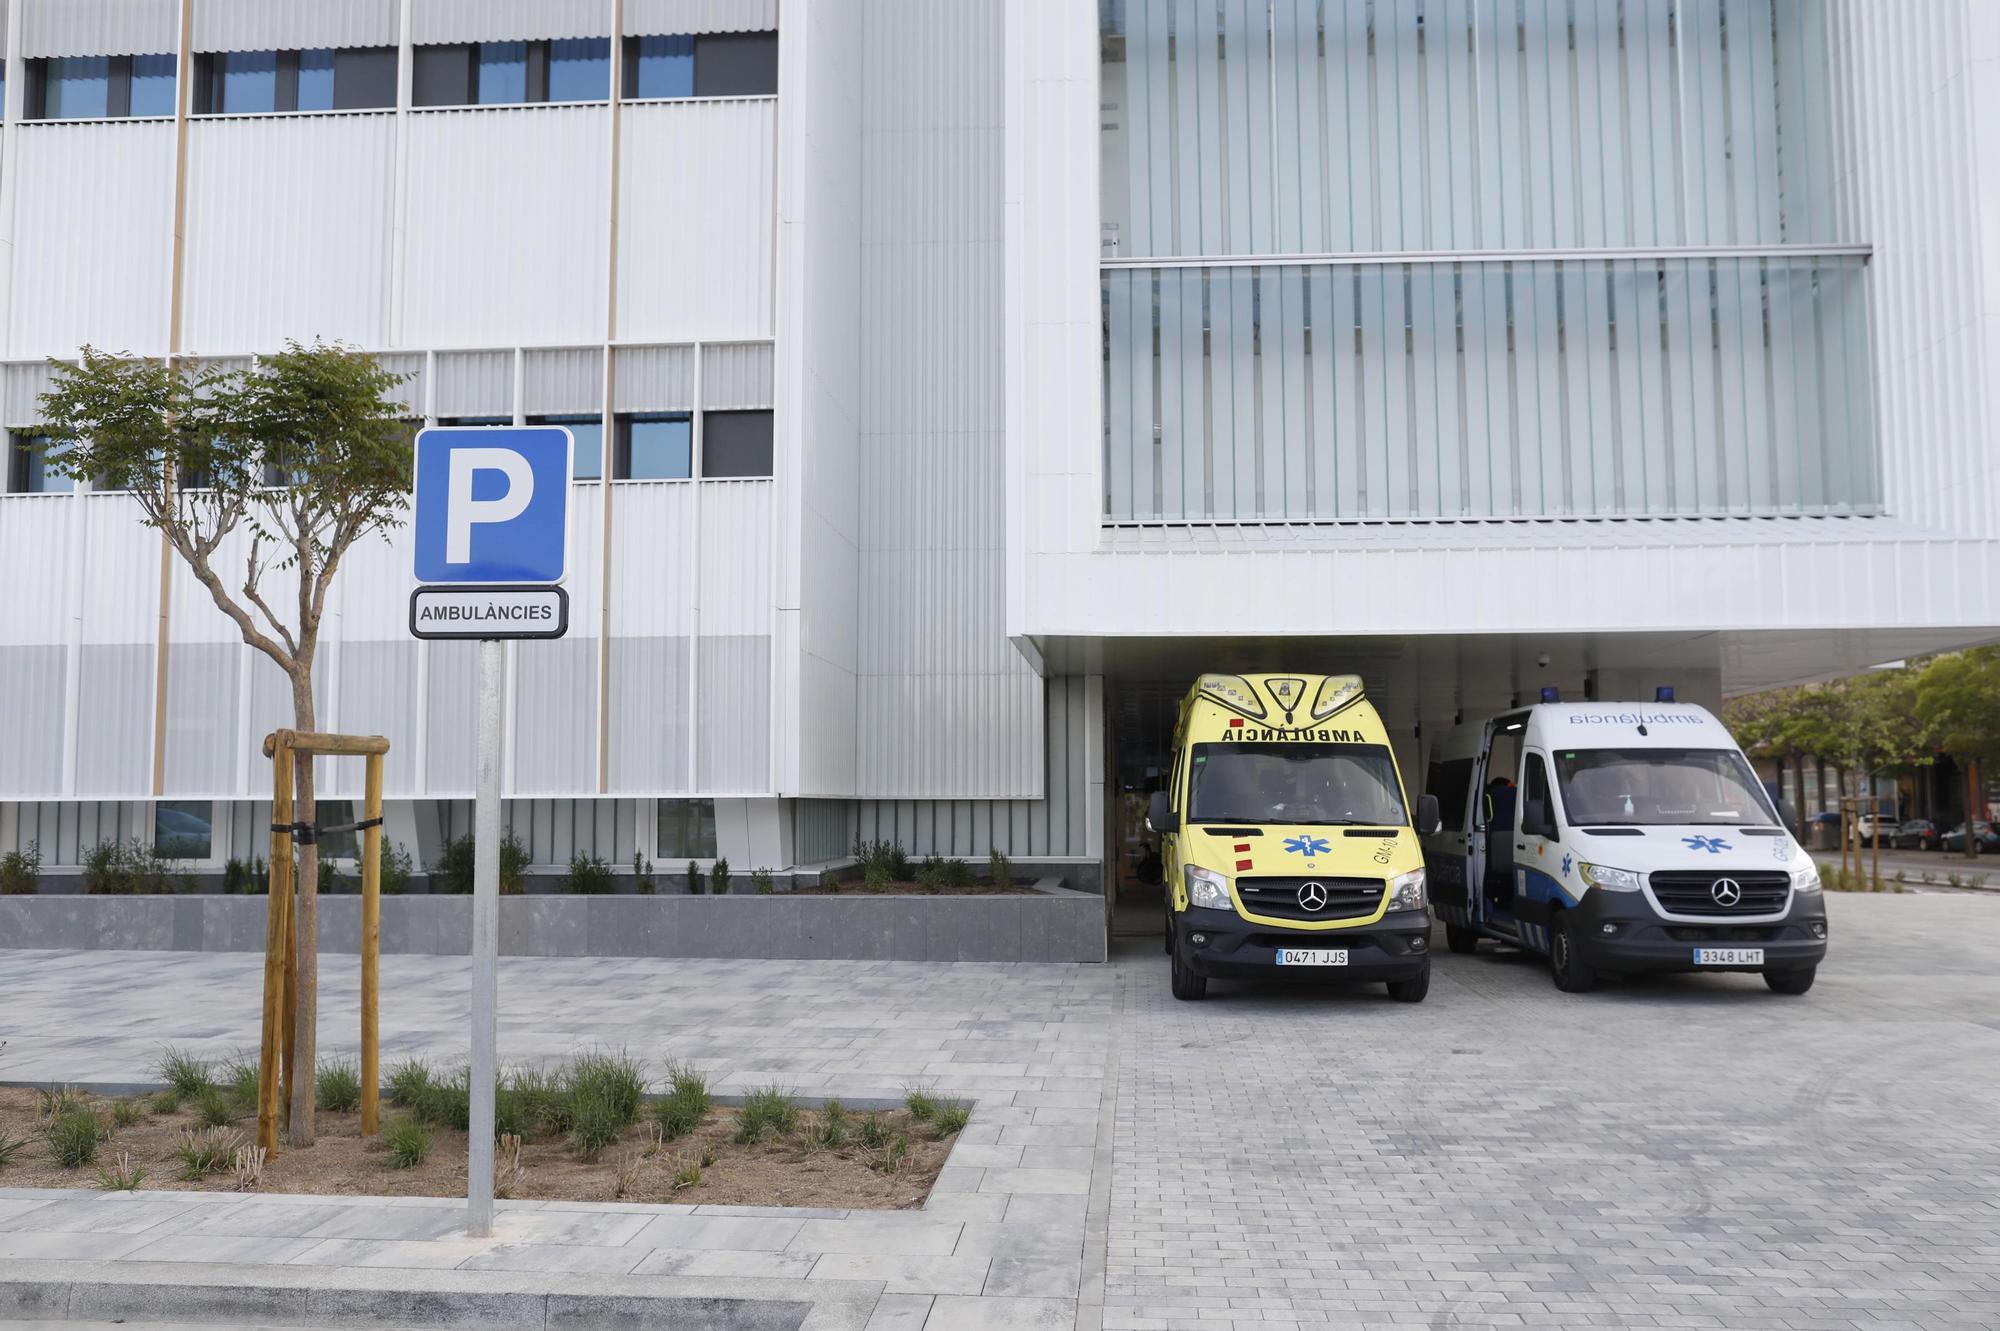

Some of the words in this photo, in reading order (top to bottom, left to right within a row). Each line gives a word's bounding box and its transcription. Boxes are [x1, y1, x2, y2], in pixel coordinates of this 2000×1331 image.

[446, 447, 535, 564] P
[420, 602, 552, 621] AMBULÀNCIES
[1285, 951, 1316, 963] 0471
[1322, 951, 1346, 964] JJS
[1703, 951, 1735, 962] 3348
[1738, 951, 1761, 963] LHT
